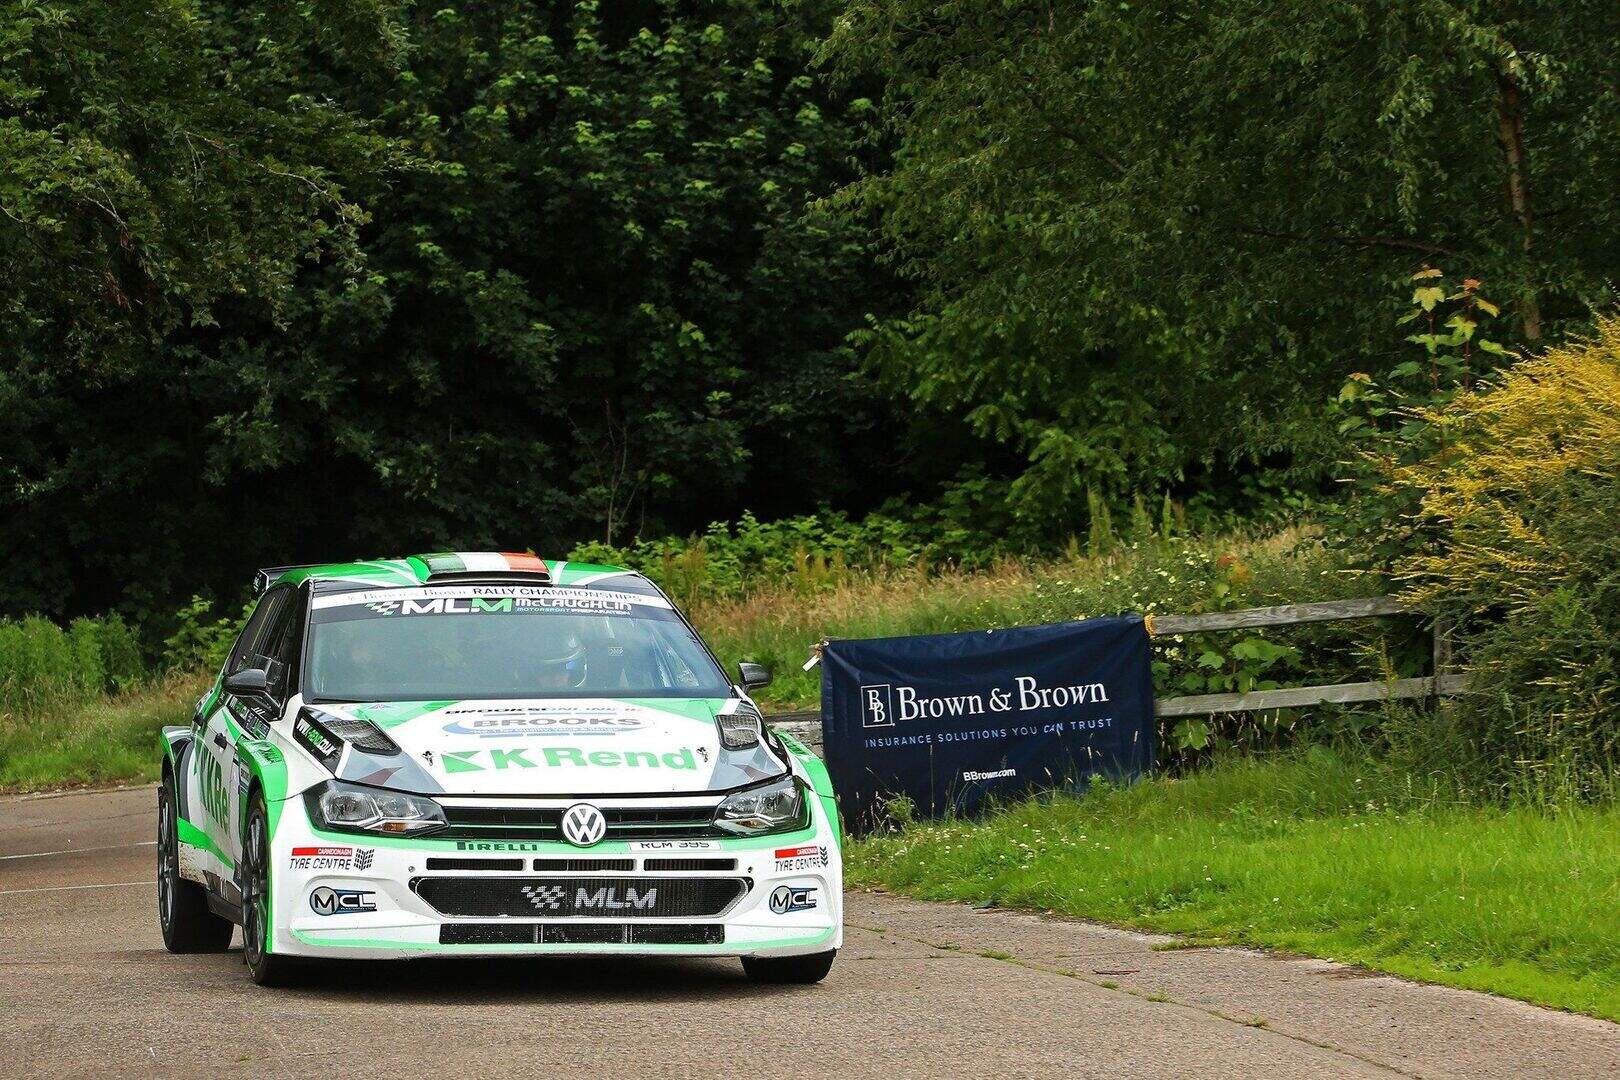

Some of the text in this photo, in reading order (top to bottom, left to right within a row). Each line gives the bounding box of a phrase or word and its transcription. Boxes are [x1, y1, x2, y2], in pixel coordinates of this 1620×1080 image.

[472, 587, 516, 595] RALLY
[519, 588, 642, 602] CHAMPIONSHIPS
[896, 676, 1110, 721] Brown & Brown
[474, 718, 642, 728] BROOKS
[865, 718, 1113, 748] INSURANCE SOLUTIONS YOU CAN TRUST
[490, 747, 697, 771] K Rend
[963, 768, 1016, 782] BBrown.com
[456, 841, 538, 851] PIRELLI
[290, 858, 352, 870] TYRE CENTRE
[775, 857, 821, 872] TYRE CENTRE
[574, 887, 658, 909] MLM
